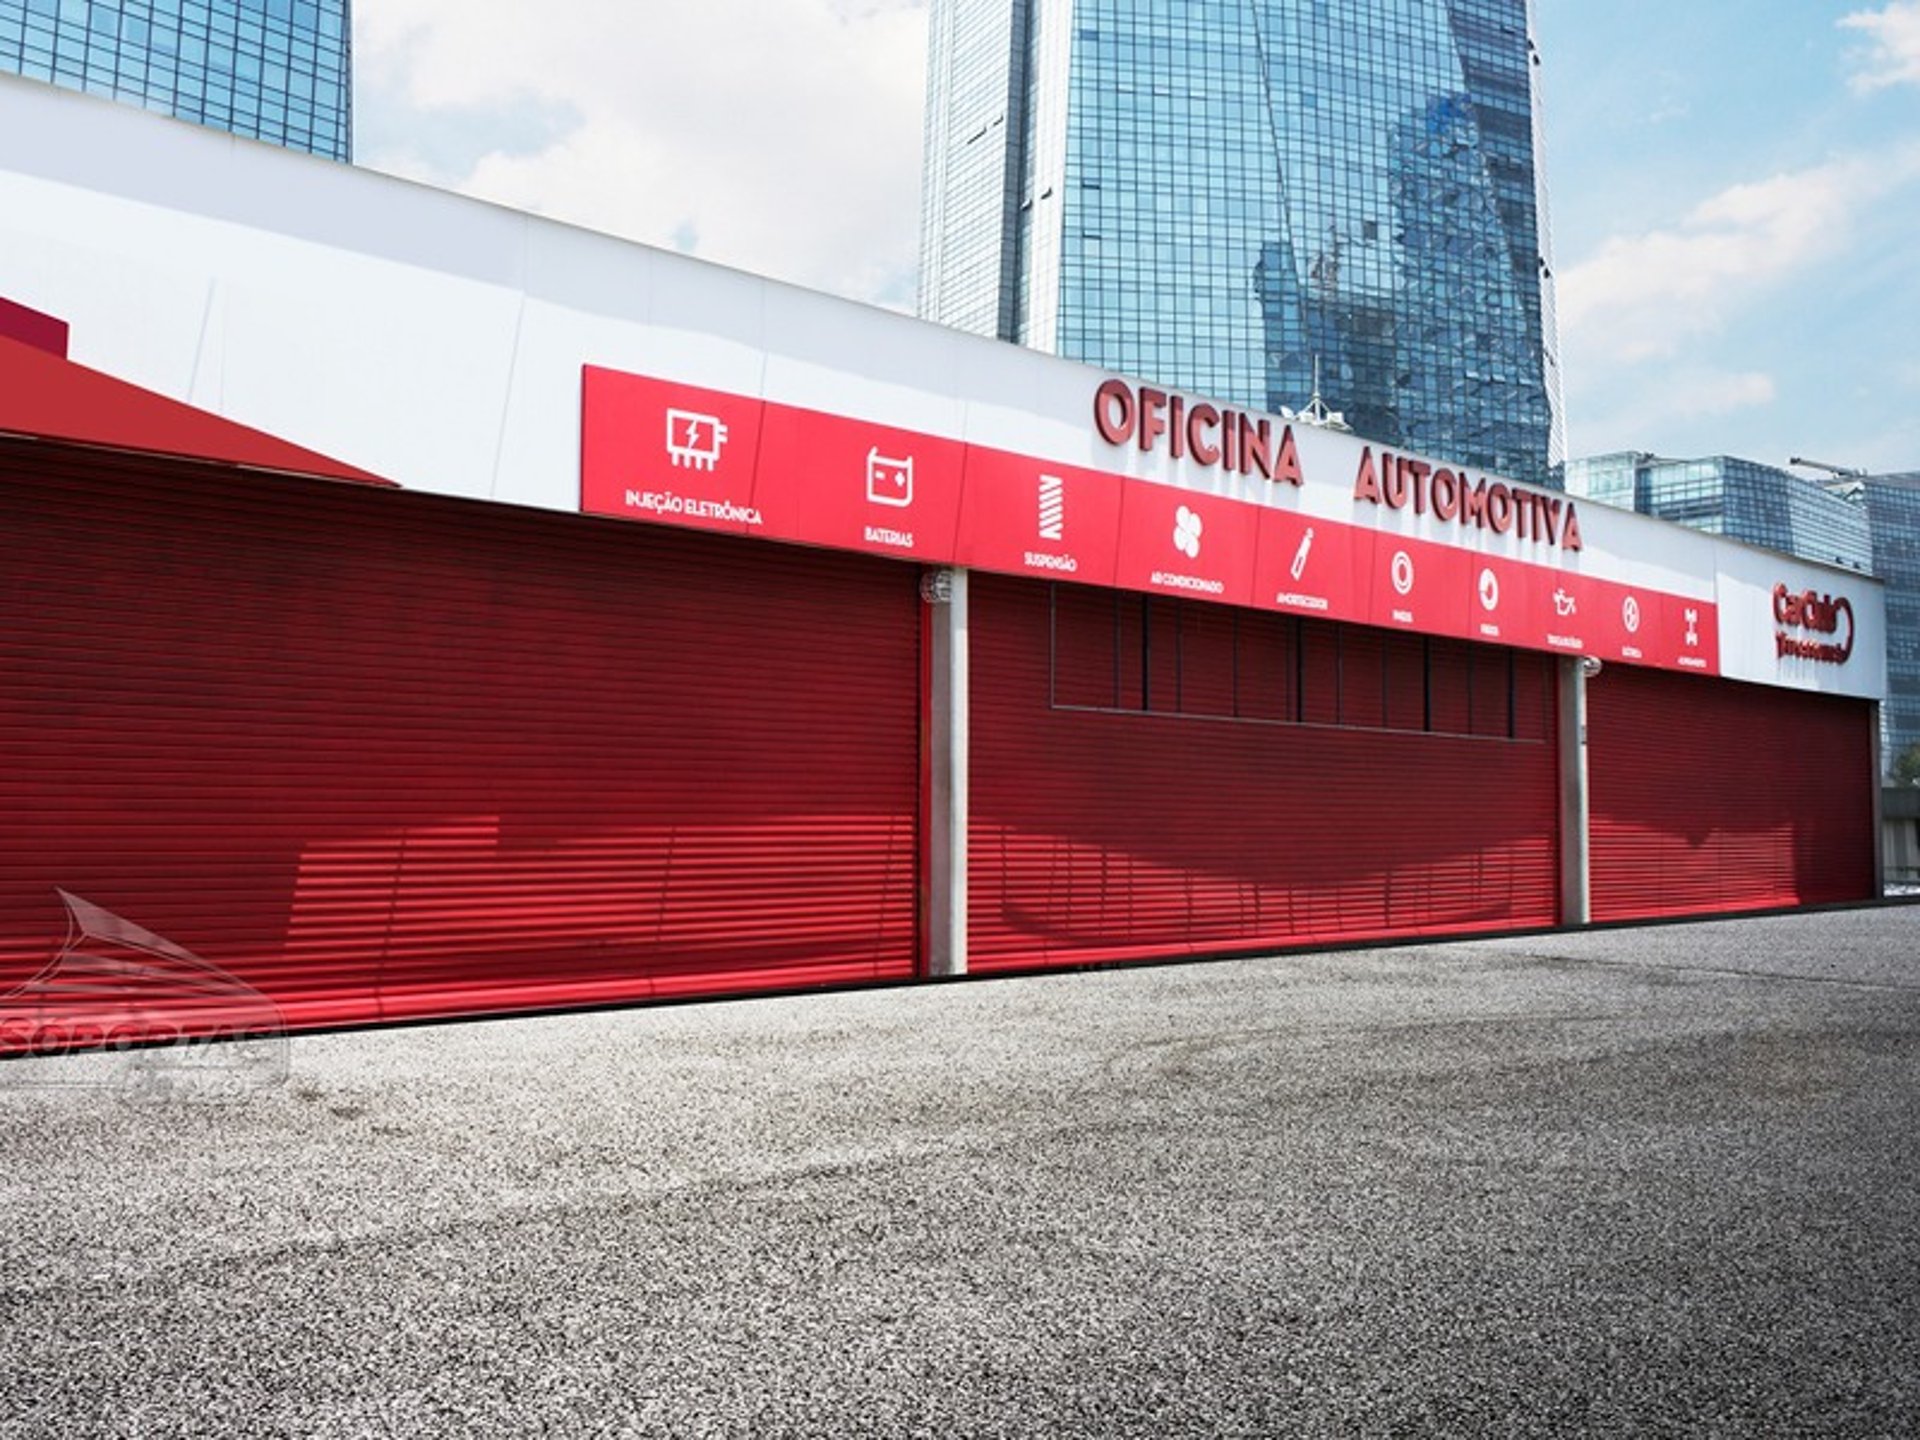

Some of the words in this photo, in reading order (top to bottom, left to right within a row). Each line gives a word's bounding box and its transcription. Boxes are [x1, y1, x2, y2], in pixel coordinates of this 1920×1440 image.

[1094, 378, 1304, 487] OFICINA
[1354, 445, 1583, 552] AUTOMOTIVA
[625, 489, 682, 514] INJEÇÃO
[685, 498, 763, 525] ELETRÔNICA
[864, 526, 914, 548] BATERIAS
